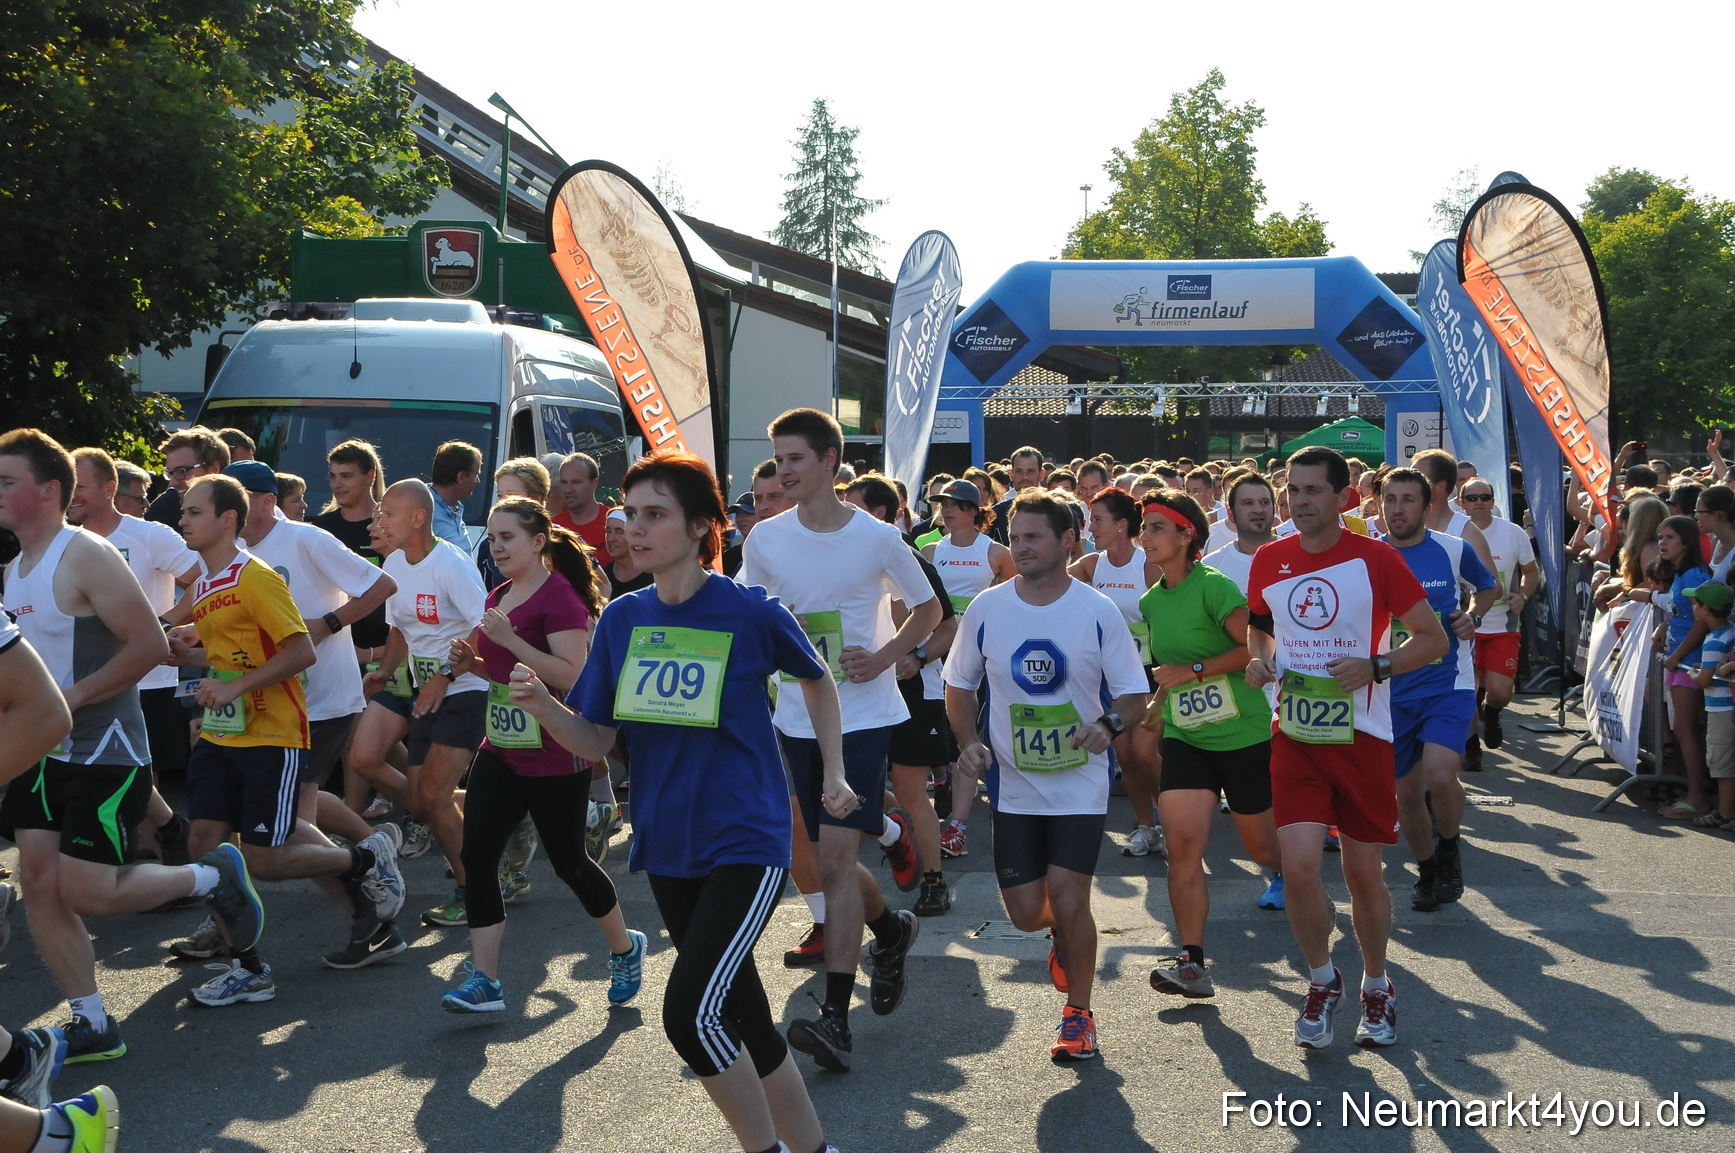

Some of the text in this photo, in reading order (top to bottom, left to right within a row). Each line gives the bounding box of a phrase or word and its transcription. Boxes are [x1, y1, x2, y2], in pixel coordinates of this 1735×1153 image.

[440, 280, 465, 292] 1628
[1151, 301, 1249, 319] firmenlauf
[906, 260, 946, 393] Fischer
[965, 334, 1017, 346] Fischer
[209, 593, 241, 612] BÖGL
[1024, 659, 1052, 672] TÜV
[635, 659, 705, 700] 709
[1032, 675, 1047, 683] SÜD
[647, 699, 667, 707] Sandra
[1178, 684, 1223, 717] 566
[490, 704, 527, 733] 590
[662, 709, 687, 717] Neumarkt
[1282, 695, 1350, 727] 1022
